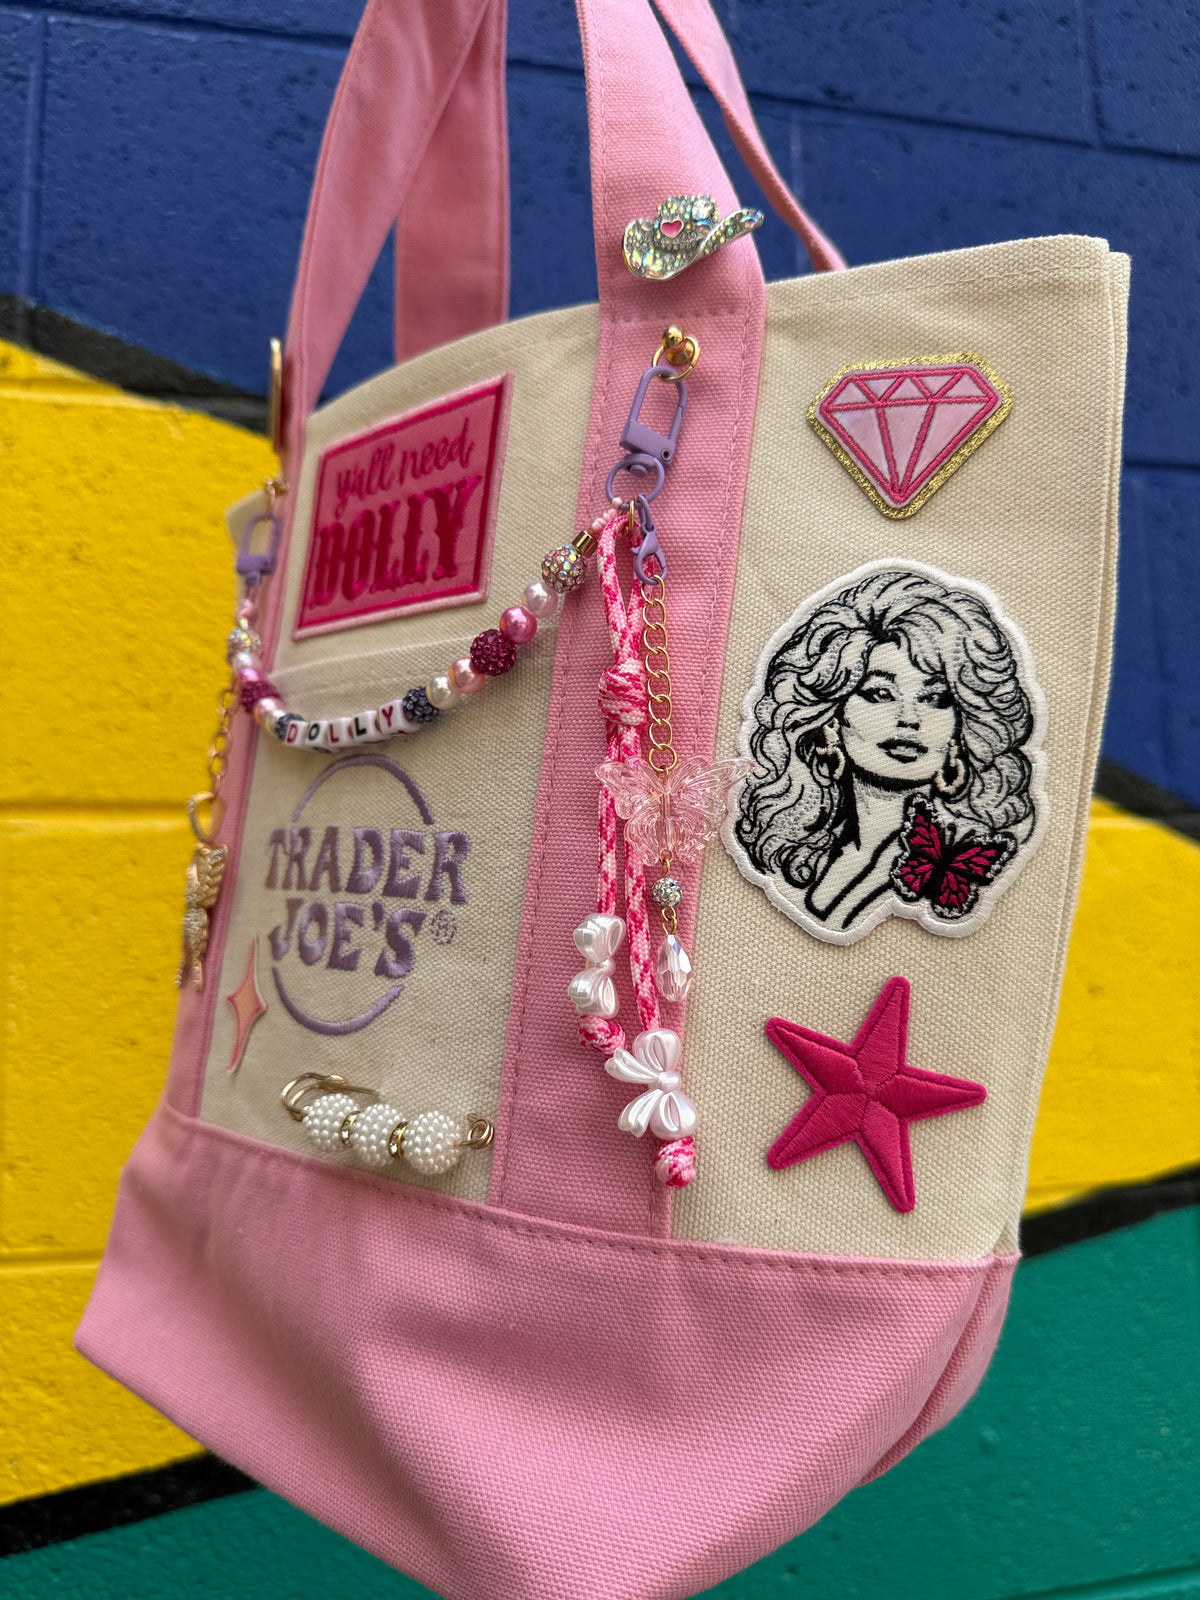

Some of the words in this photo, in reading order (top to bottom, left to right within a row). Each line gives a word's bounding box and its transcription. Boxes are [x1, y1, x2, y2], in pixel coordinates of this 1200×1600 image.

[335, 442, 396, 520] y'all
[400, 416, 476, 487] need
[309, 472, 484, 609] DOLLY
[285, 705, 394, 744] DOLLY
[265, 825, 472, 905] TRADER
